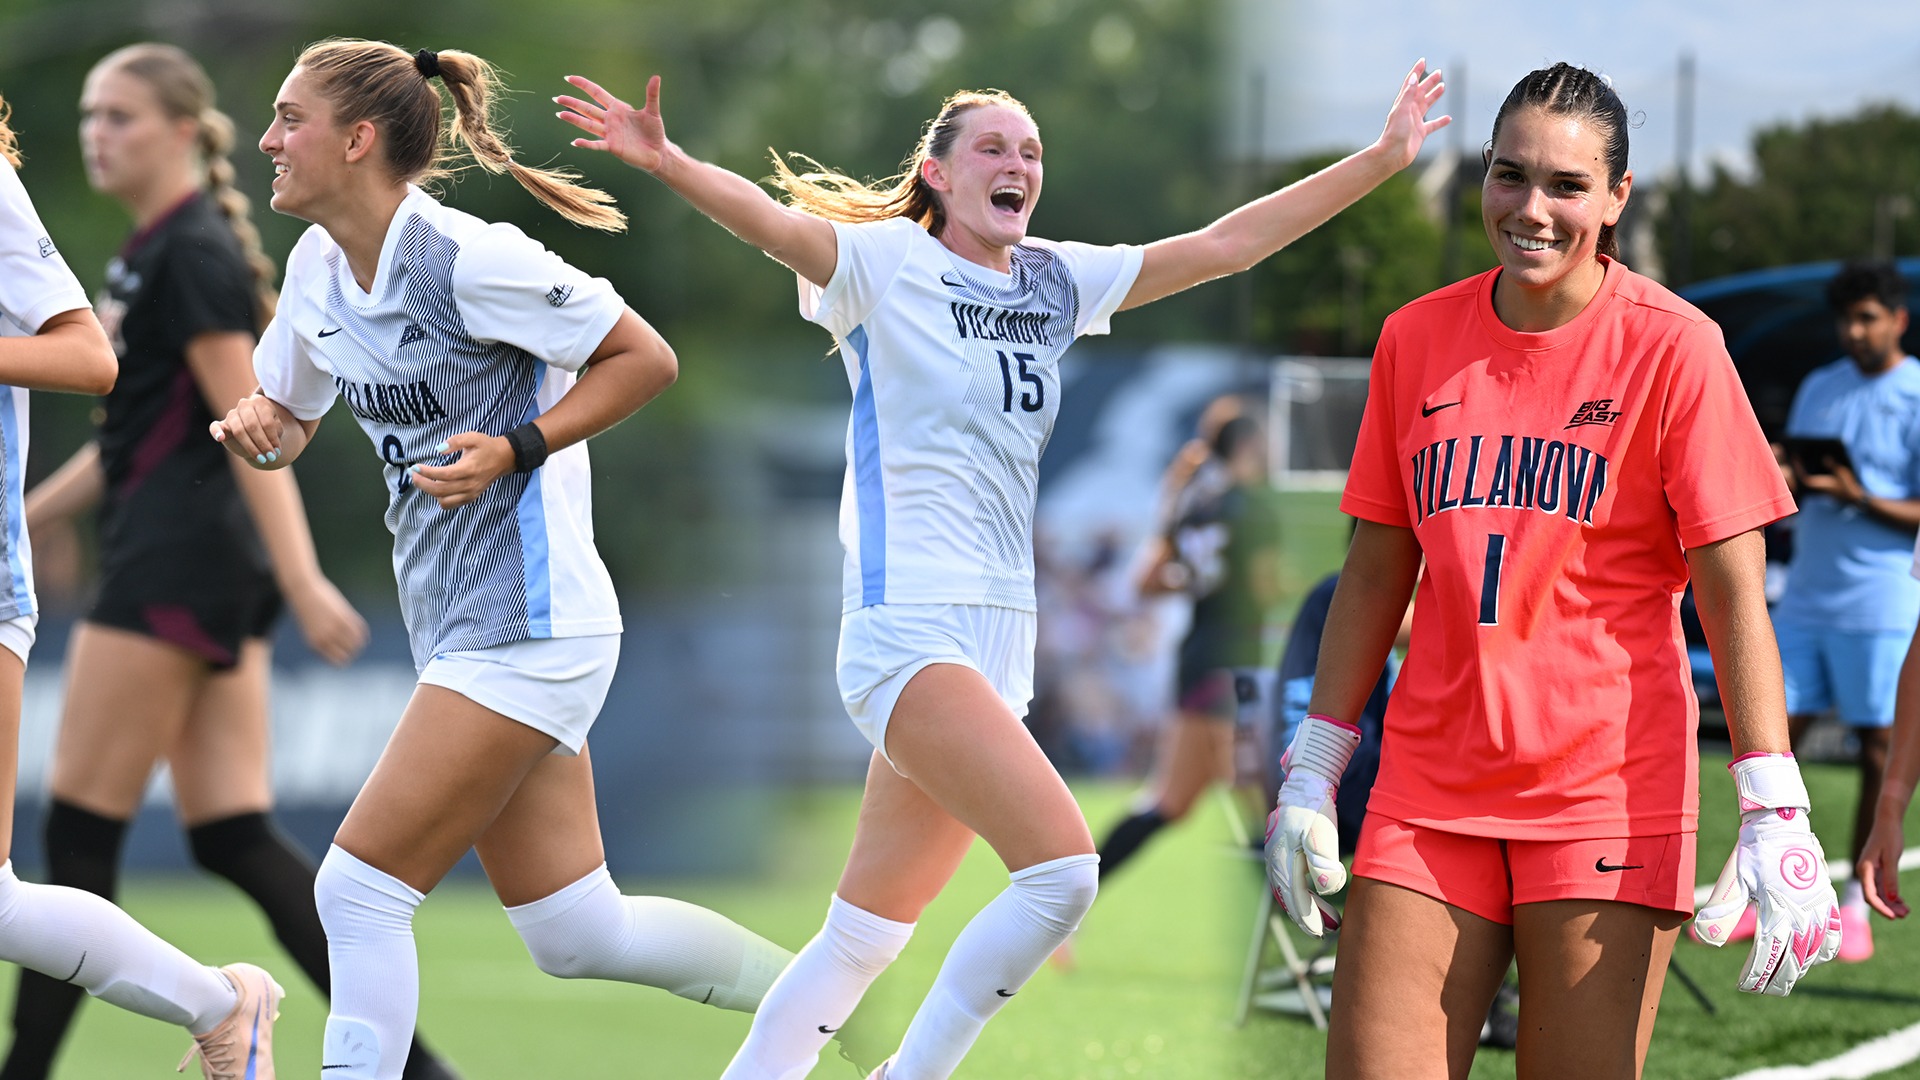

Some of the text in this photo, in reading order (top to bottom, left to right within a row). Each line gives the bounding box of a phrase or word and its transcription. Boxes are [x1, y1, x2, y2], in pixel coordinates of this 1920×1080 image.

[995, 350, 1044, 412] 15
[1568, 411, 1623, 424] EAST
[1577, 399, 1614, 413] BIG
[1477, 533, 1506, 626] 1
[1766, 936, 1783, 971] COAST
